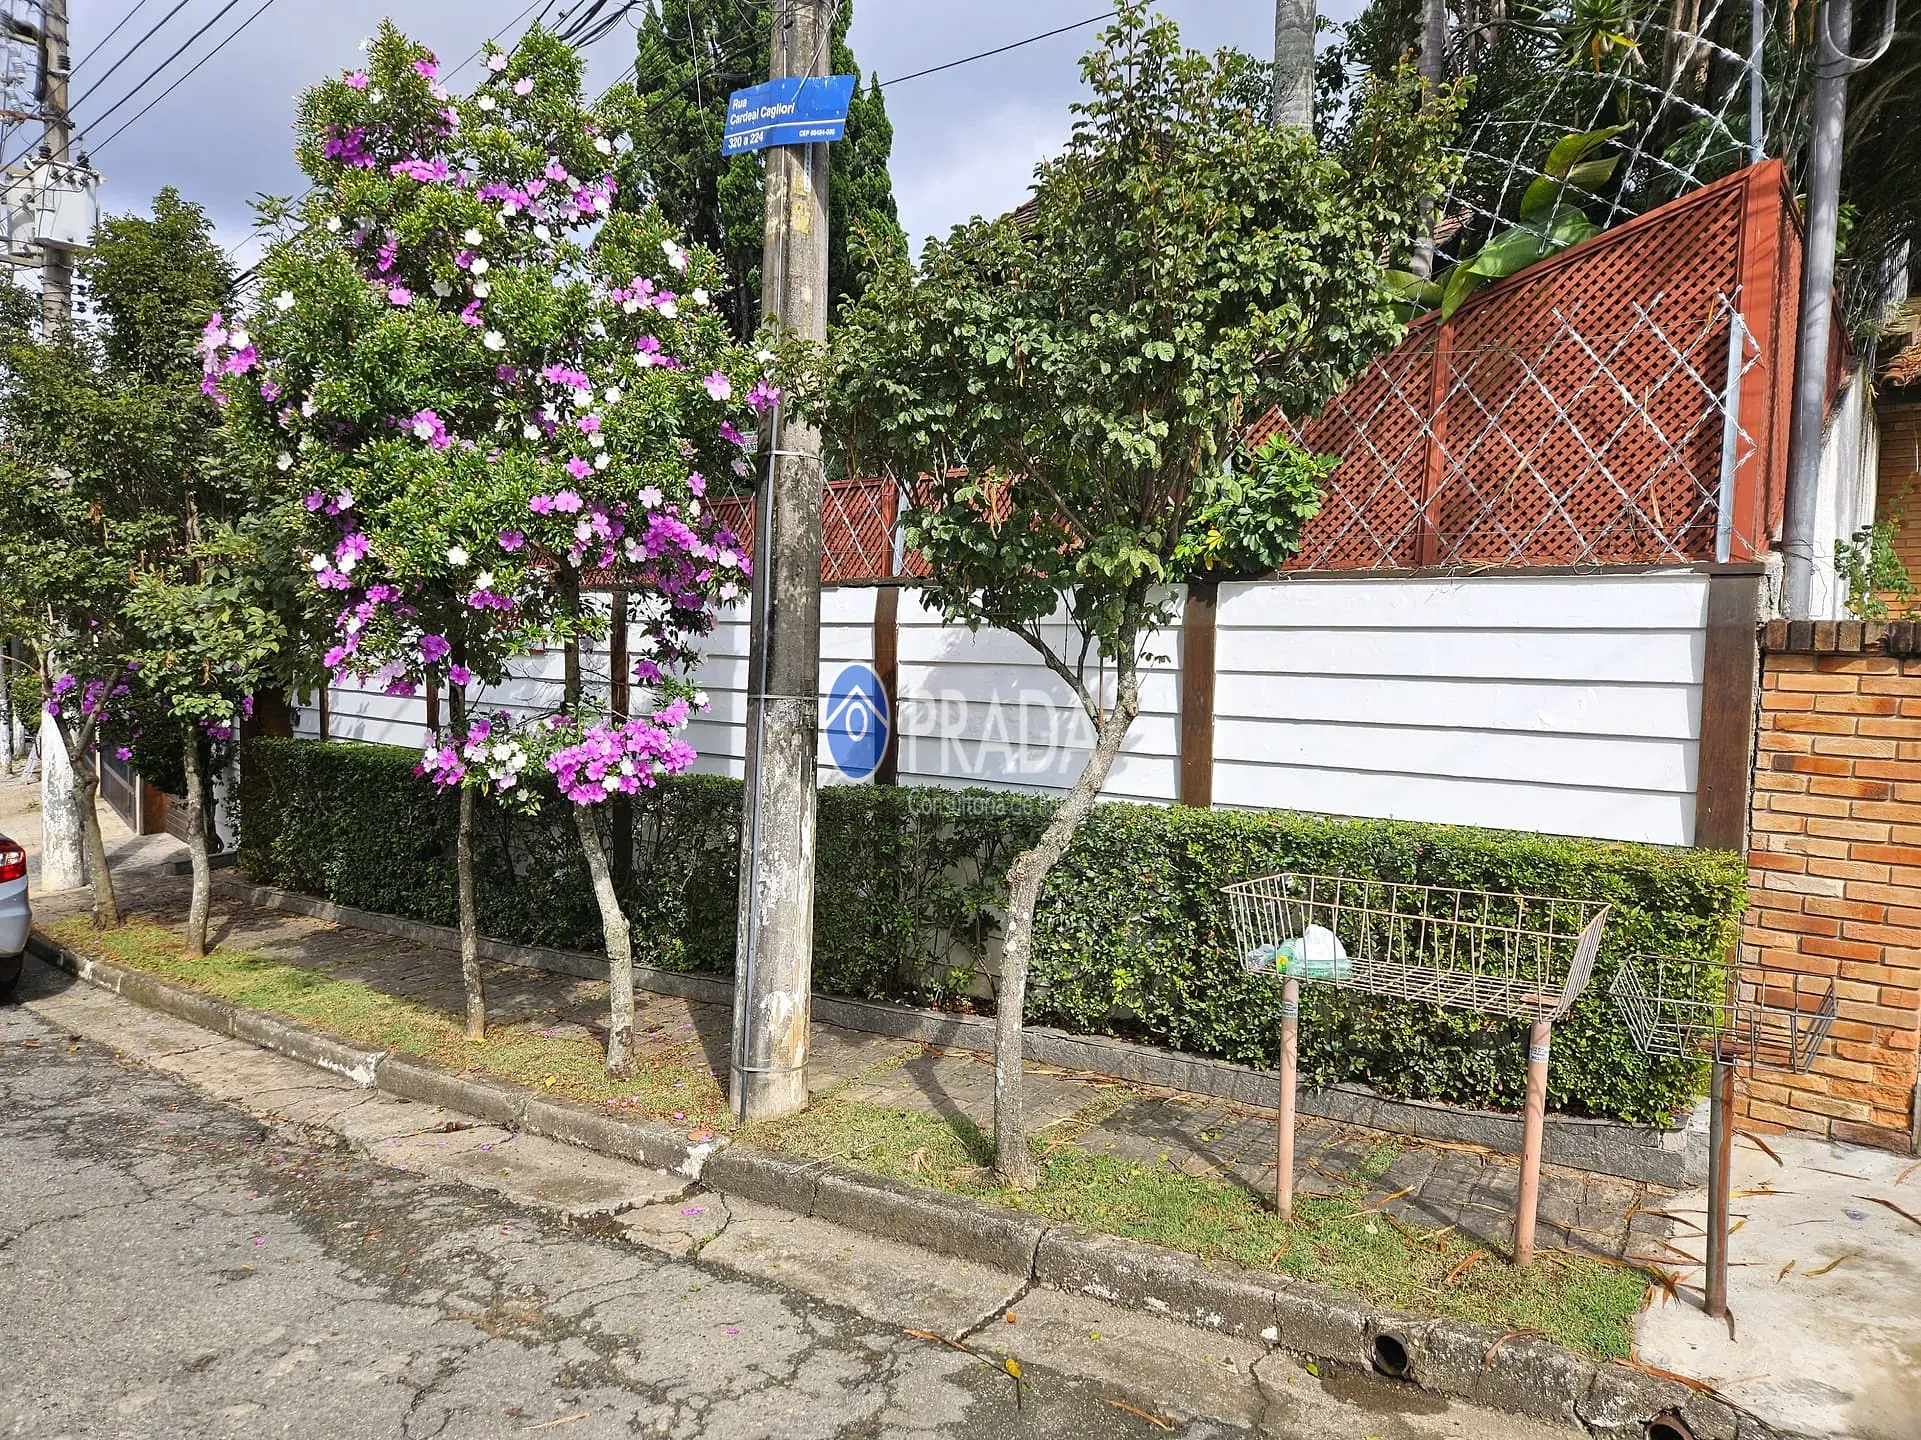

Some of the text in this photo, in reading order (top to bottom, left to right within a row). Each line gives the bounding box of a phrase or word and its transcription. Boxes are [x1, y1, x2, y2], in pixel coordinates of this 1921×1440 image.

[732, 98, 748, 111] Rua
[730, 102, 796, 126] Cardeal Cagliori
[728, 135, 743, 149] 320
[749, 131, 764, 144] 224
[798, 129, 810, 137] CEP
